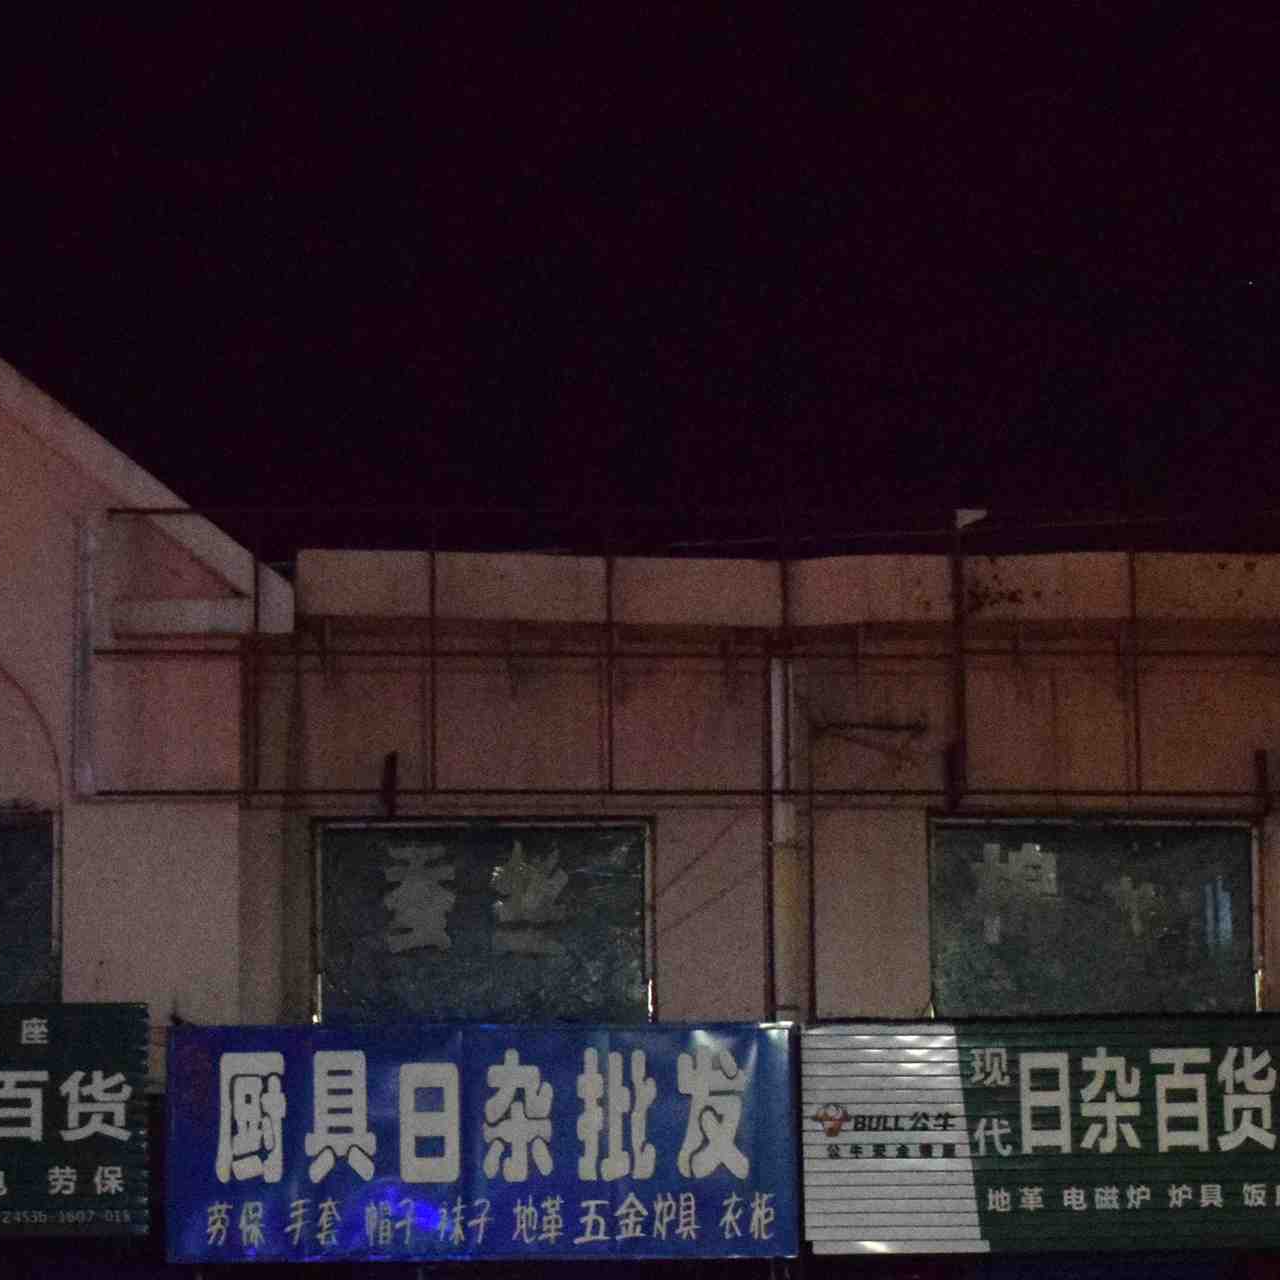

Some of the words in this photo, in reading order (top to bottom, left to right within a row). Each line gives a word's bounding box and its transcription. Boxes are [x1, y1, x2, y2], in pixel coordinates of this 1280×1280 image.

[214, 1046, 751, 1184] 厨具日杂批发
[853, 1115, 905, 1132] BULL
[910, 1112, 956, 1132] 公牛
[970, 1047, 1013, 1156] 现代
[47, 1165, 125, 1196] 劳保
[986, 1184, 1044, 1213] 地革
[1062, 1183, 1152, 1212] 电磁炉
[1167, 1183, 1224, 1210] 炉具
[206, 1199, 266, 1248] 劳保
[283, 1196, 342, 1247] 手套
[511, 1194, 564, 1244] 地革
[719, 1191, 776, 1241] 衣柜
